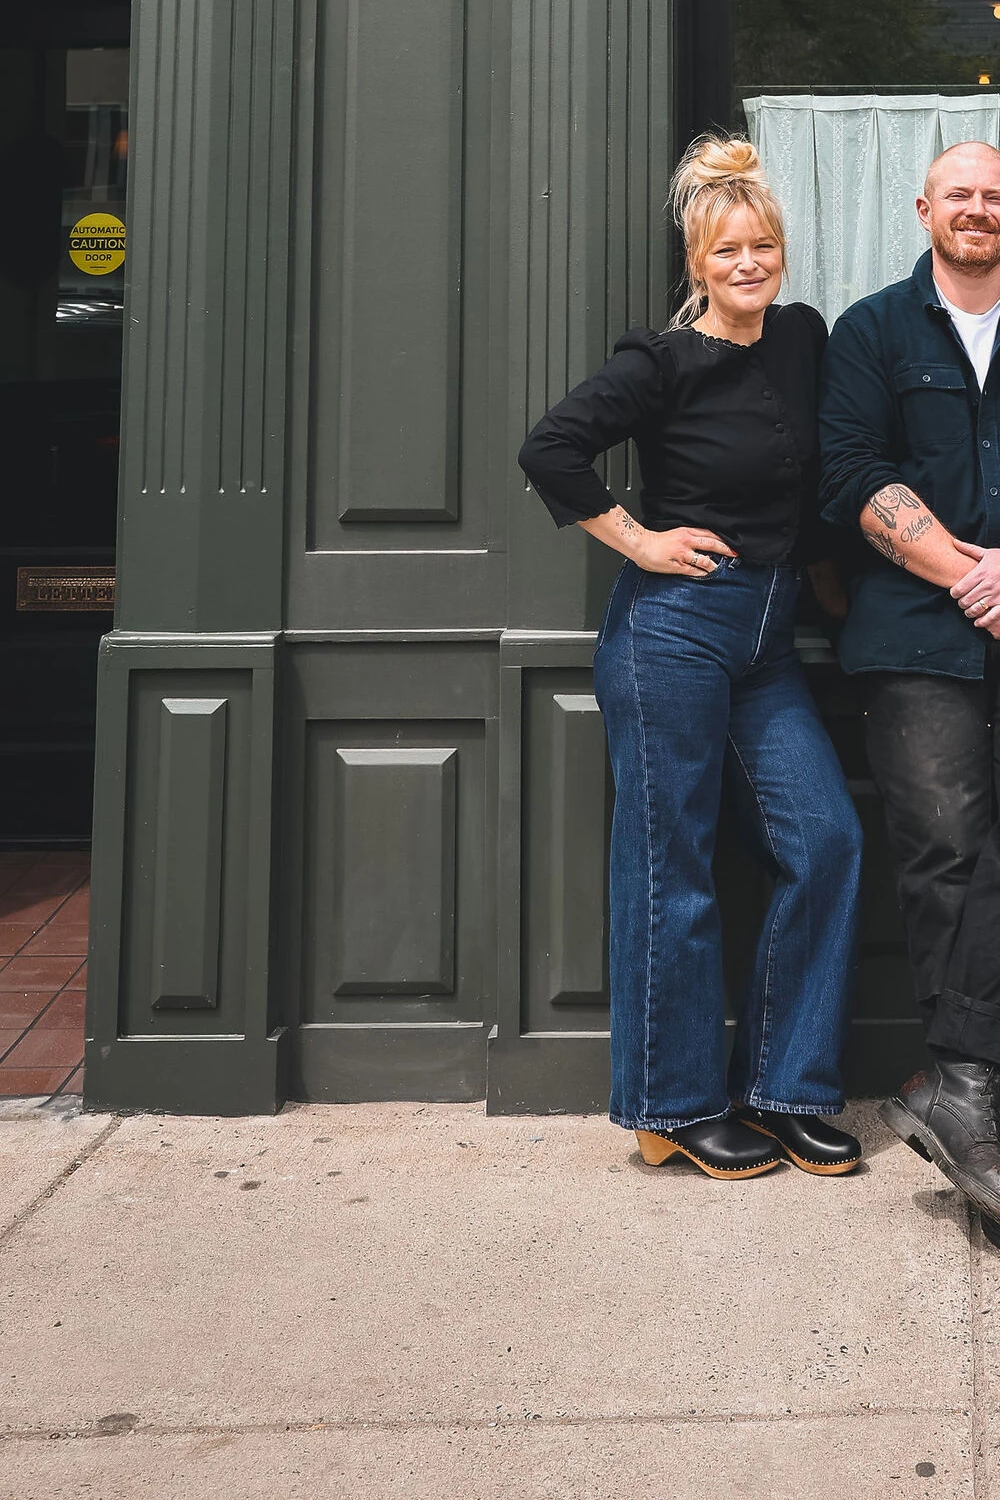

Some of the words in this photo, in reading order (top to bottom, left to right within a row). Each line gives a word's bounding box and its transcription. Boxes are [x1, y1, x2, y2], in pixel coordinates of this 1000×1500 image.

[72, 226, 125, 234] AUTOMATIC
[71, 239, 126, 249] CAUTION
[900, 514, 934, 543] Mickey
